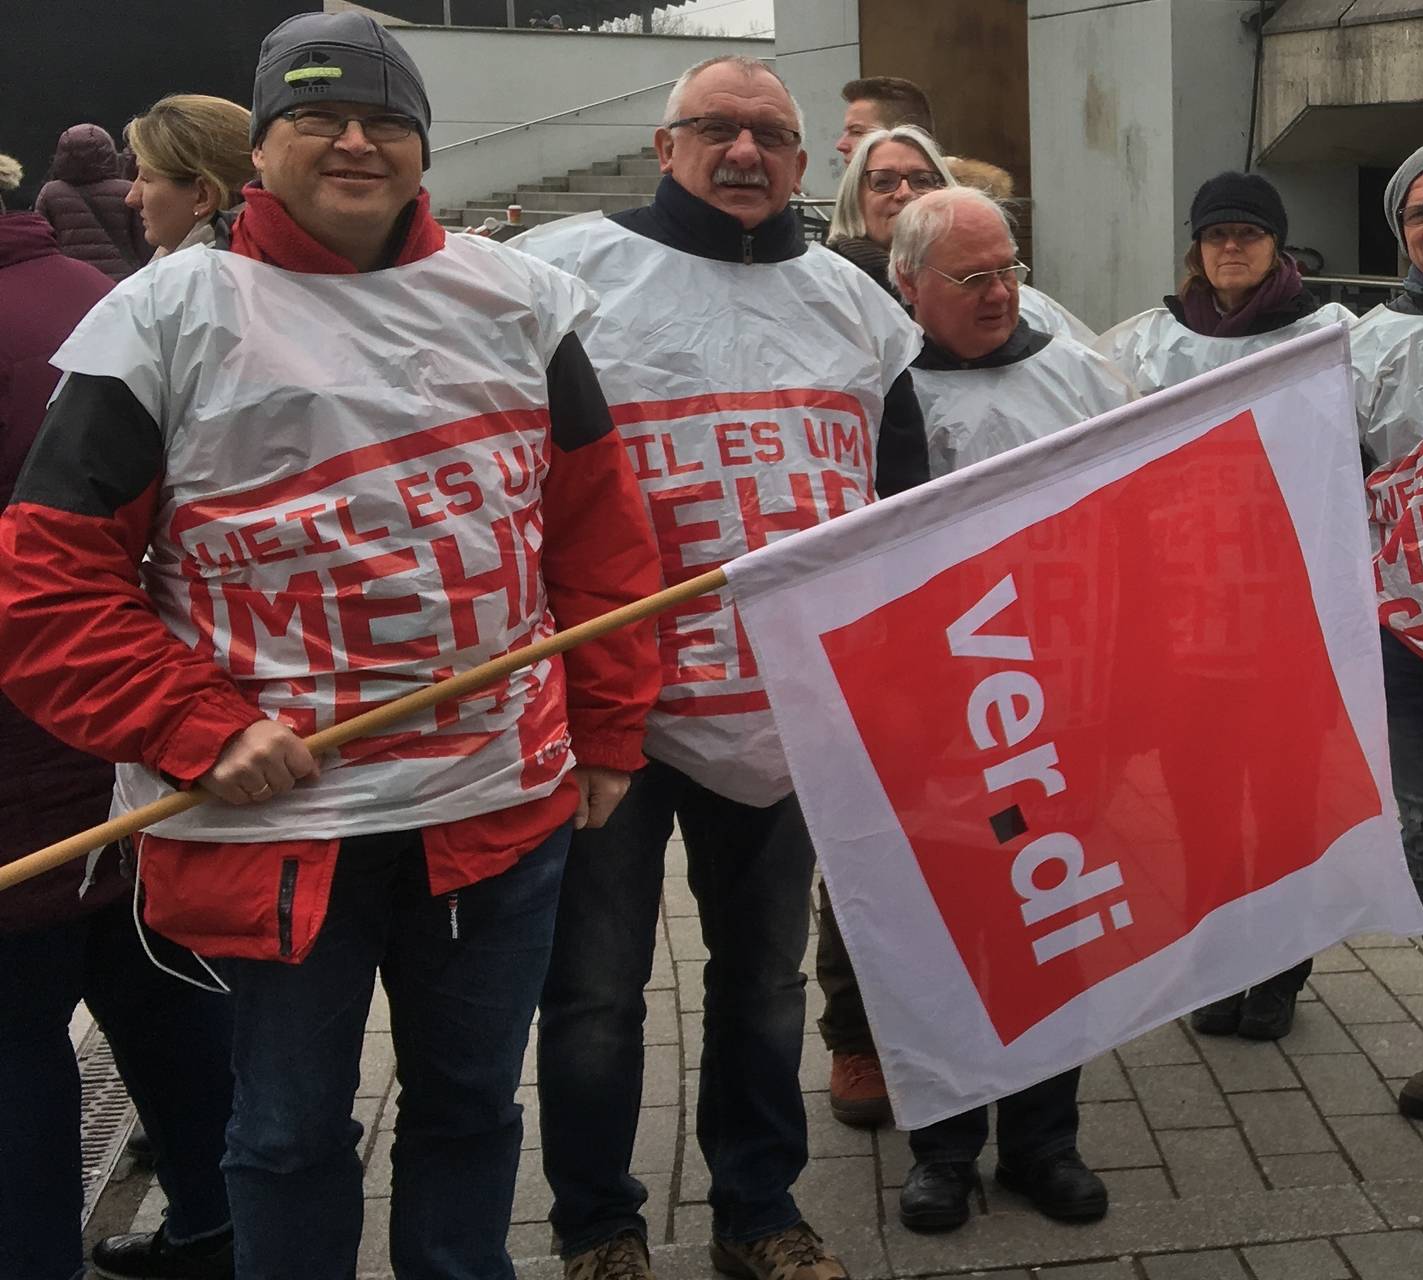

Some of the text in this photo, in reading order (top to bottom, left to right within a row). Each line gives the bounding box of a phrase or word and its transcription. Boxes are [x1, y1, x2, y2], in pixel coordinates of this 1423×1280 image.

[714, 421, 785, 467] ES
[803, 417, 861, 467] UM
[196, 495, 390, 574] WEIL
[394, 461, 484, 529] ES
[945, 573, 1134, 967] ver.di
